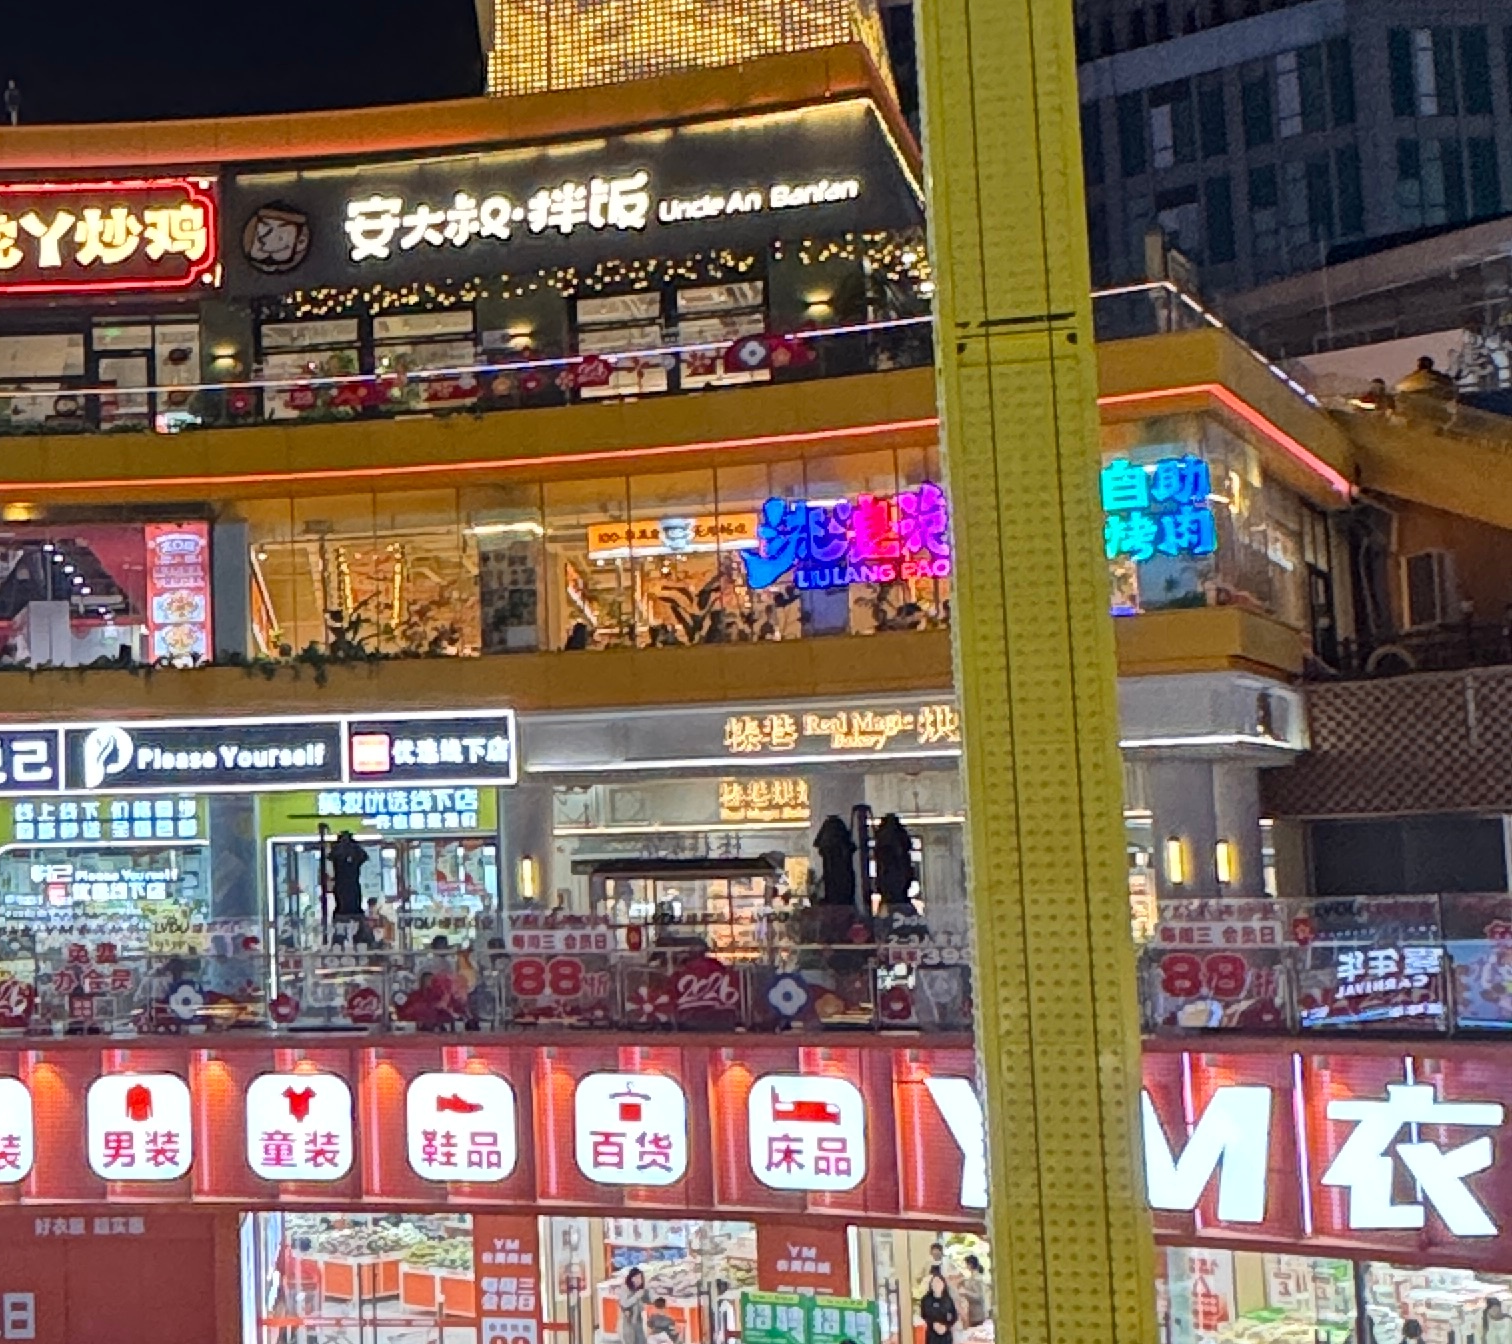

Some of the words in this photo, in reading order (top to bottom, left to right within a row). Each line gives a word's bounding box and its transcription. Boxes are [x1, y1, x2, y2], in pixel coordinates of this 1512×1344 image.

[1101, 455, 1210, 513] 自助
[1105, 509, 1217, 561] 烤肉
[797, 561, 896, 587] LIULANG
[901, 558, 950, 580] PAO
[803, 711, 848, 736] Real
[850, 709, 915, 737] Magic
[831, 733, 887, 750] Bakery
[138, 746, 217, 771] Please
[219, 743, 326, 769] Yourself
[67, 942, 118, 963] 免费
[563, 935, 607, 950] 会员日
[53, 969, 134, 992] 办会员
[510, 956, 584, 997] 88
[1161, 953, 1248, 998] 88
[102, 1130, 181, 1168] 男装
[259, 1129, 340, 1167] 童装
[420, 1129, 503, 1168] 鞋品
[589, 1131, 675, 1171] 百货
[763, 1133, 854, 1177] 床品
[1321, 1084, 1504, 1236] 衣
